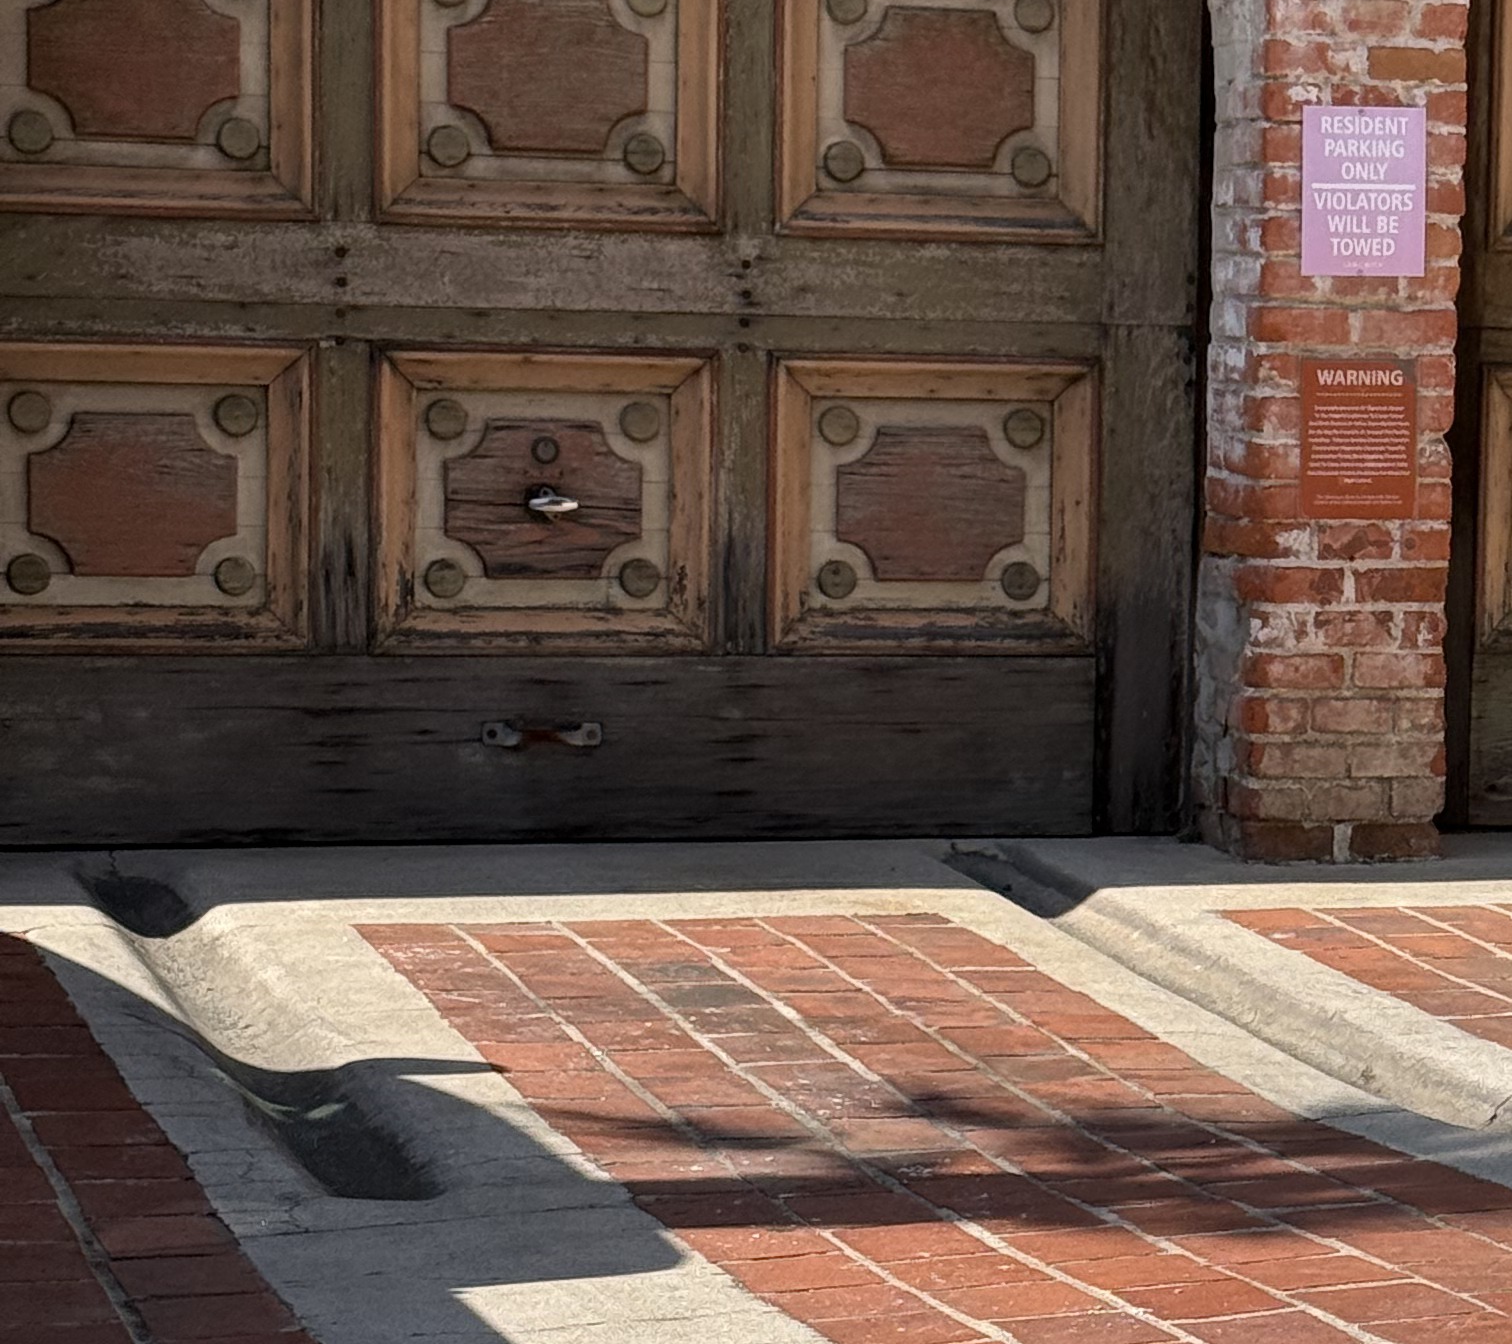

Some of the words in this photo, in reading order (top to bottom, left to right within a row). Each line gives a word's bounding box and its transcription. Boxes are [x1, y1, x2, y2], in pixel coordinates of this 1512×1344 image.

[1320, 116, 1409, 136] RESIDENT
[1324, 139, 1405, 158] PARKING
[1341, 162, 1388, 181] ONLY
[1313, 192, 1414, 212] VIOLATORS
[1327, 215, 1371, 234] WILL
[1377, 215, 1399, 234] BE
[1330, 237, 1396, 256] TOWED
[1316, 369, 1404, 386] WARNING
